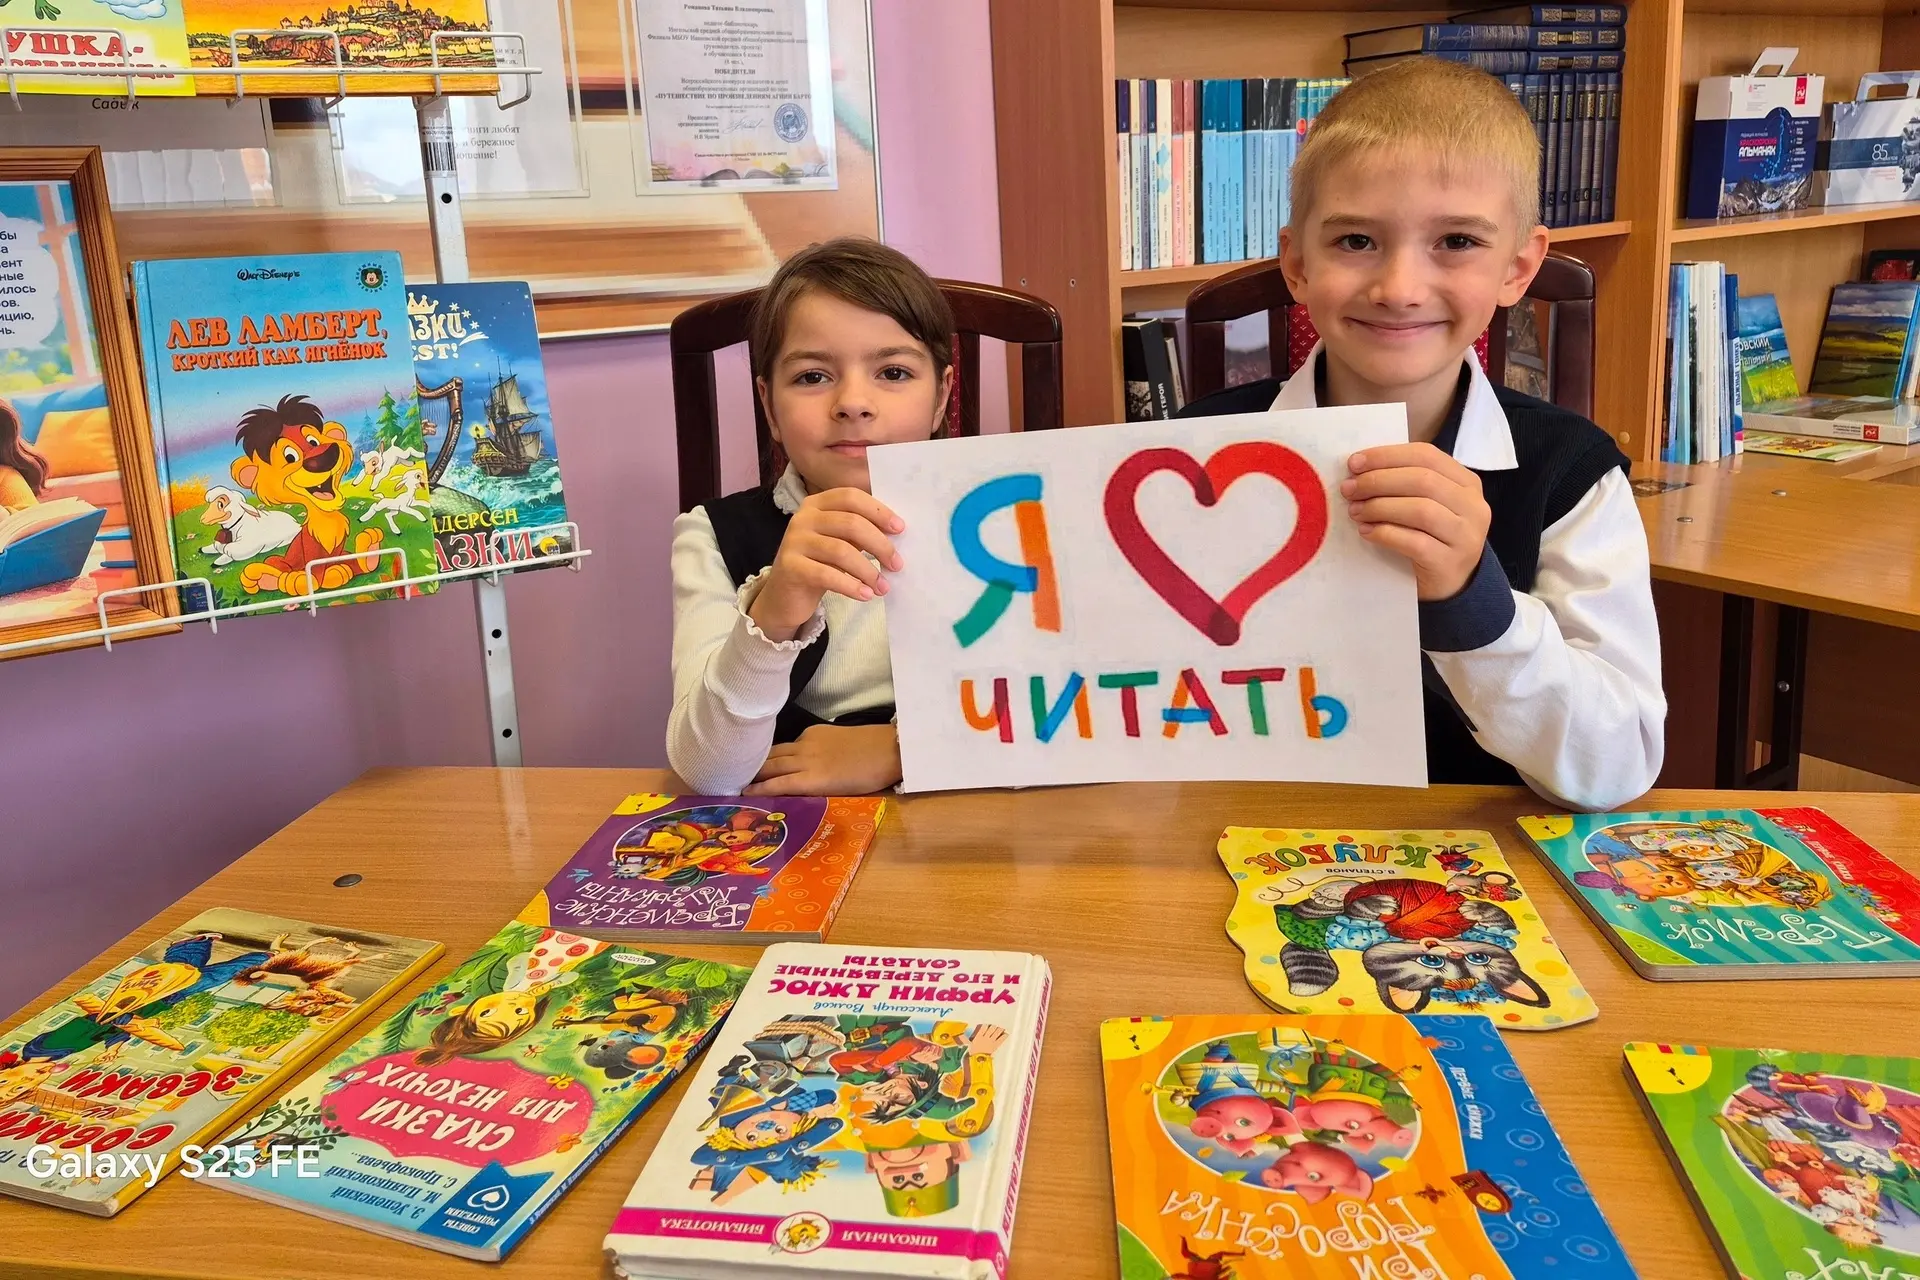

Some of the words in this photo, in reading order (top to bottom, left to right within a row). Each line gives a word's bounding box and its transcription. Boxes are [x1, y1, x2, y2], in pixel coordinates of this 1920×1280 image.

[471, 136, 516, 148] бережное
[1871, 143, 1889, 161] 85
[166, 316, 230, 349] ЛЕВ
[238, 308, 388, 345] ЛАМБЕРТ,
[172, 346, 259, 371] КРОТКИЙ
[262, 347, 302, 366] КАК
[305, 338, 387, 362] ЯГНЁНОК
[412, 343, 459, 361] ST!
[1157, 382, 1167, 409] ГЕРОЯ
[949, 473, 1061, 649] Я
[959, 666, 1348, 744] ЧИТАТЬ
[1244, 843, 1432, 875] КЛУБОК
[842, 954, 961, 969] СОЛДАТЫ
[773, 964, 947, 983] ДЕРЕВЯННЫЕ
[951, 972, 994, 985] ЕГО
[996, 973, 1021, 985] И
[766, 978, 880, 1000] ДЖЮС
[887, 984, 1016, 1006] УРФИН
[812, 1000, 865, 1016] Волков
[872, 1001, 954, 1019] Александр
[54, 1063, 245, 1101] ЗЕВАКИ
[365, 1061, 505, 1109] НЕХОЧУХ
[504, 1096, 577, 1125] ДЛЯ
[0, 1108, 177, 1154] СОБАКИ
[355, 1095, 515, 1152] СКАЗКИ
[350, 1150, 443, 1188] Прокофьева...
[323, 1165, 427, 1203] Пляцковский
[443, 1174, 459, 1190] С.
[329, 1185, 410, 1220] Успенский
[427, 1190, 442, 1204] М.
[413, 1205, 426, 1219] Э.
[443, 1206, 499, 1227] РОДИТЕЛЯМ
[441, 1217, 481, 1236] СОВЕТЫ
[660, 1216, 766, 1236] БИБЛИОТЕКА
[841, 1229, 939, 1247] ШКОЛЬНАЯ
